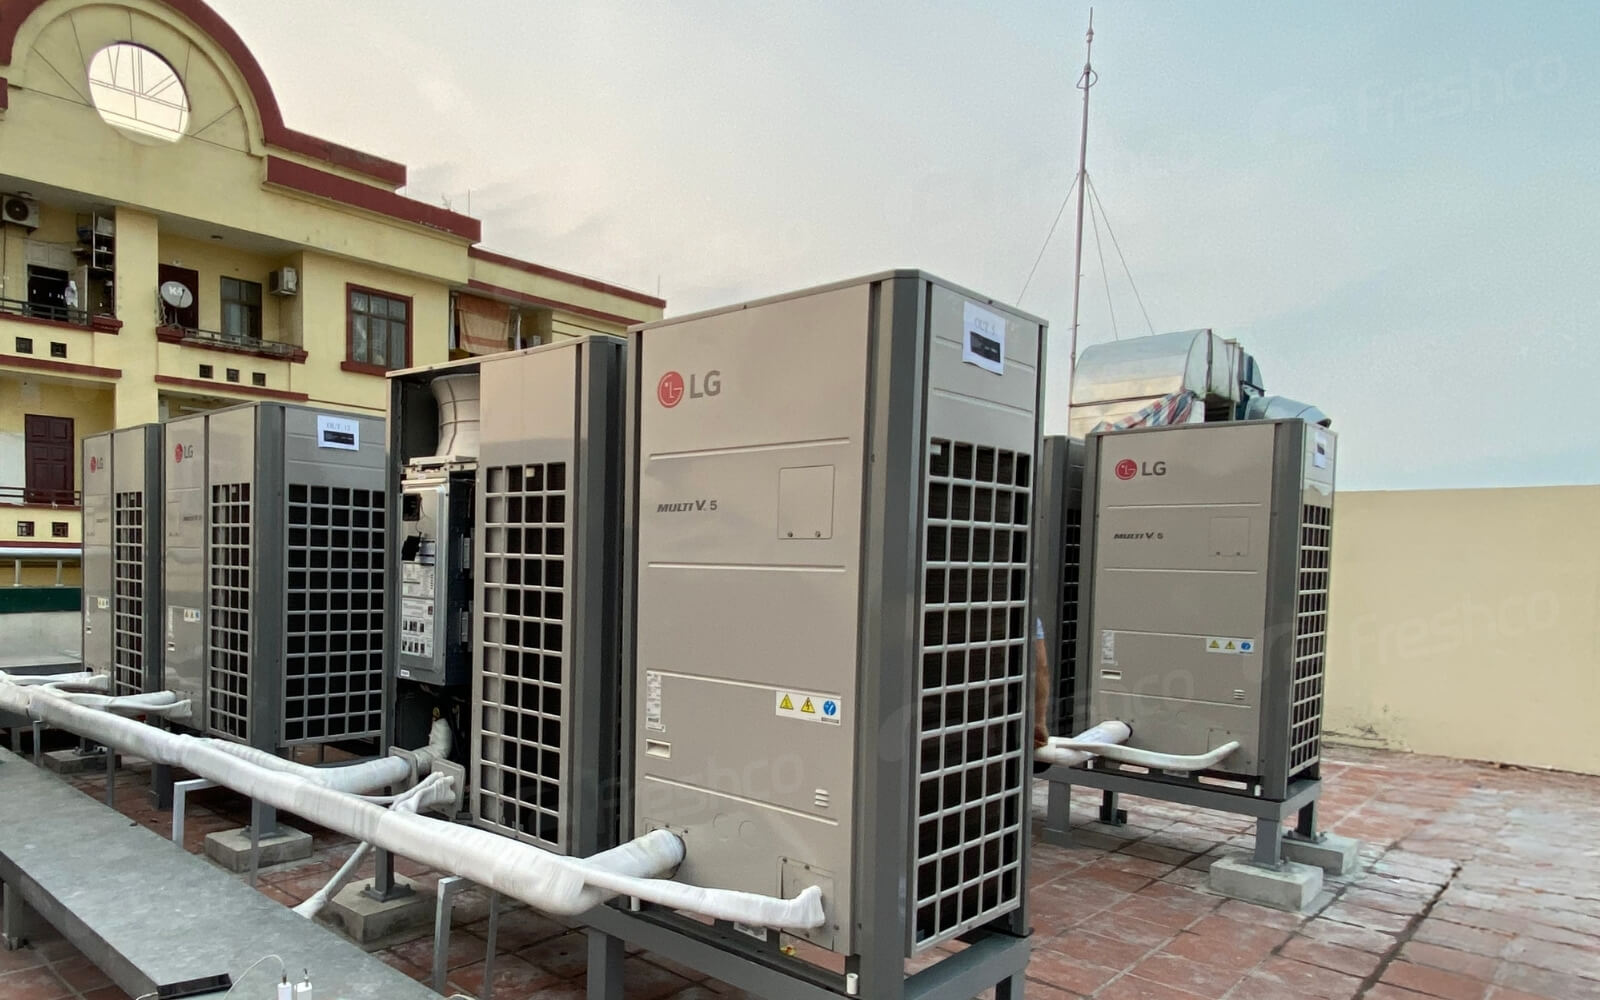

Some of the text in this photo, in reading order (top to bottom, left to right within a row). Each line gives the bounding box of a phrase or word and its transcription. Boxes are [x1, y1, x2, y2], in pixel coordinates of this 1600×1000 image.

[690, 370, 721, 399] LG
[183, 445, 194, 459] LG
[1142, 461, 1167, 476] LG
[656, 503, 694, 512] MULTI
